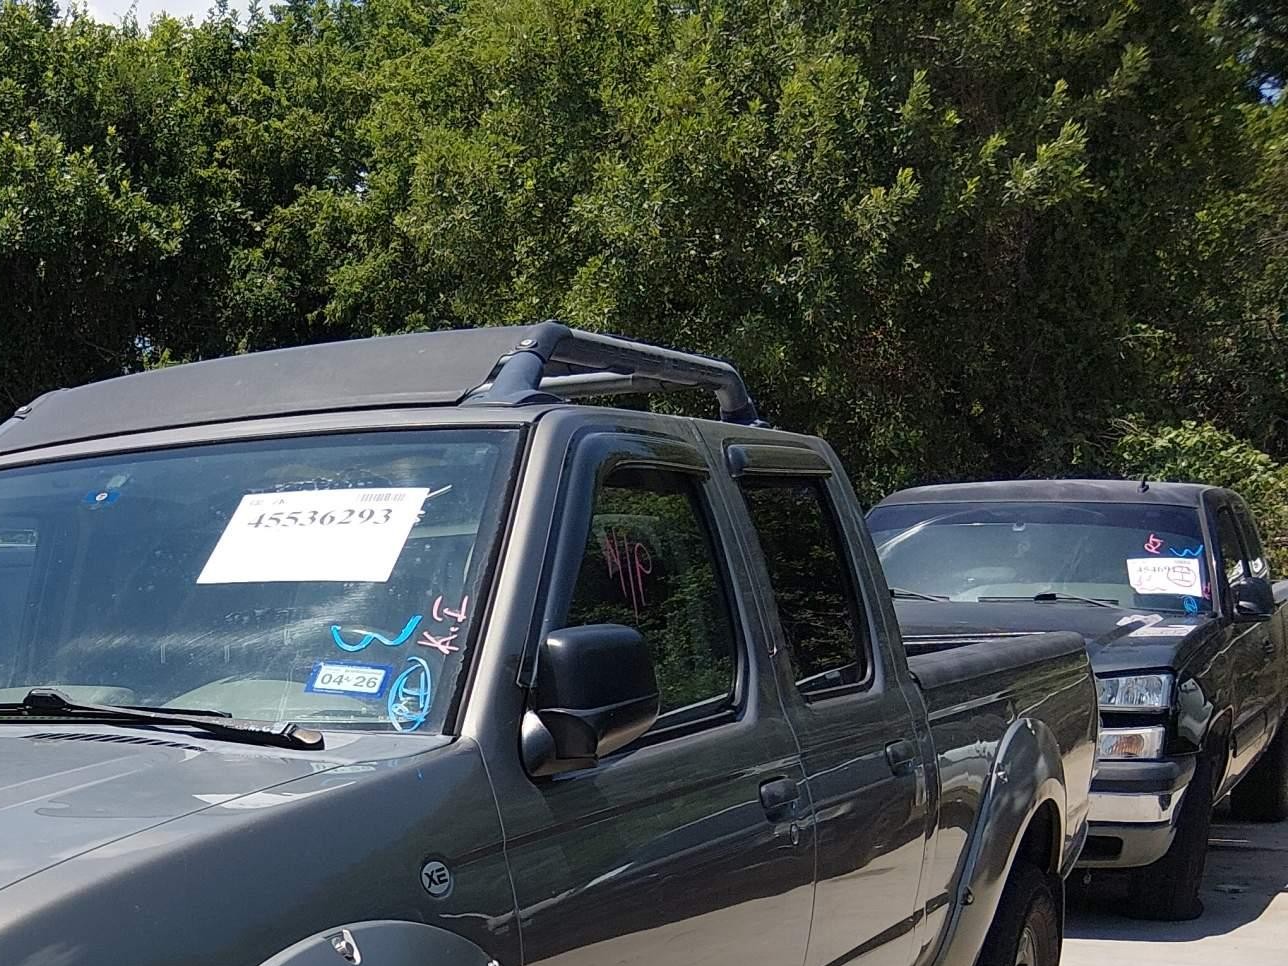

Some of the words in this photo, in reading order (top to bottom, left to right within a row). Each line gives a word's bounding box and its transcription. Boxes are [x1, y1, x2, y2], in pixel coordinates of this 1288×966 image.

[247, 508, 393, 529] 45536293
[320, 673, 345, 686] 04
[352, 675, 379, 689] 26
[424, 866, 449, 889] XE
